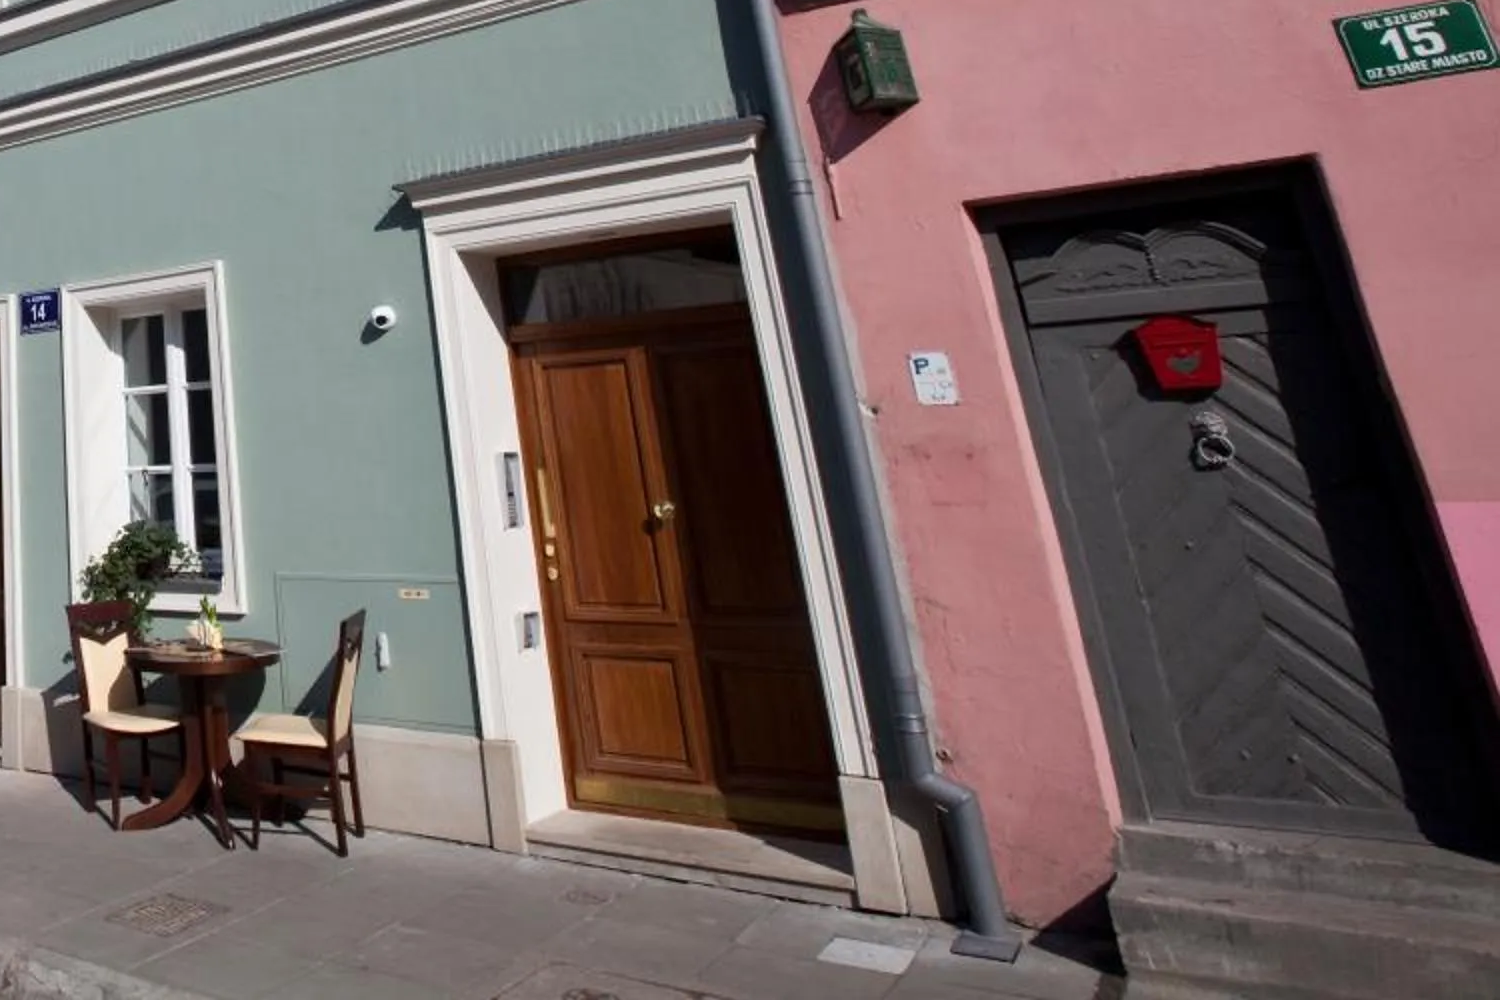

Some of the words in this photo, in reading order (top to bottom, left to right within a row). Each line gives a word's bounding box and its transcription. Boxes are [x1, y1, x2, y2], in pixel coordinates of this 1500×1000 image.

[1383, 6, 1450, 27] SZEROKA
[1379, 21, 1447, 61] 15
[1385, 59, 1430, 78] STARE
[1431, 49, 1488, 69] MIASTO
[30, 302, 46, 322] 14
[913, 357, 929, 375] P
